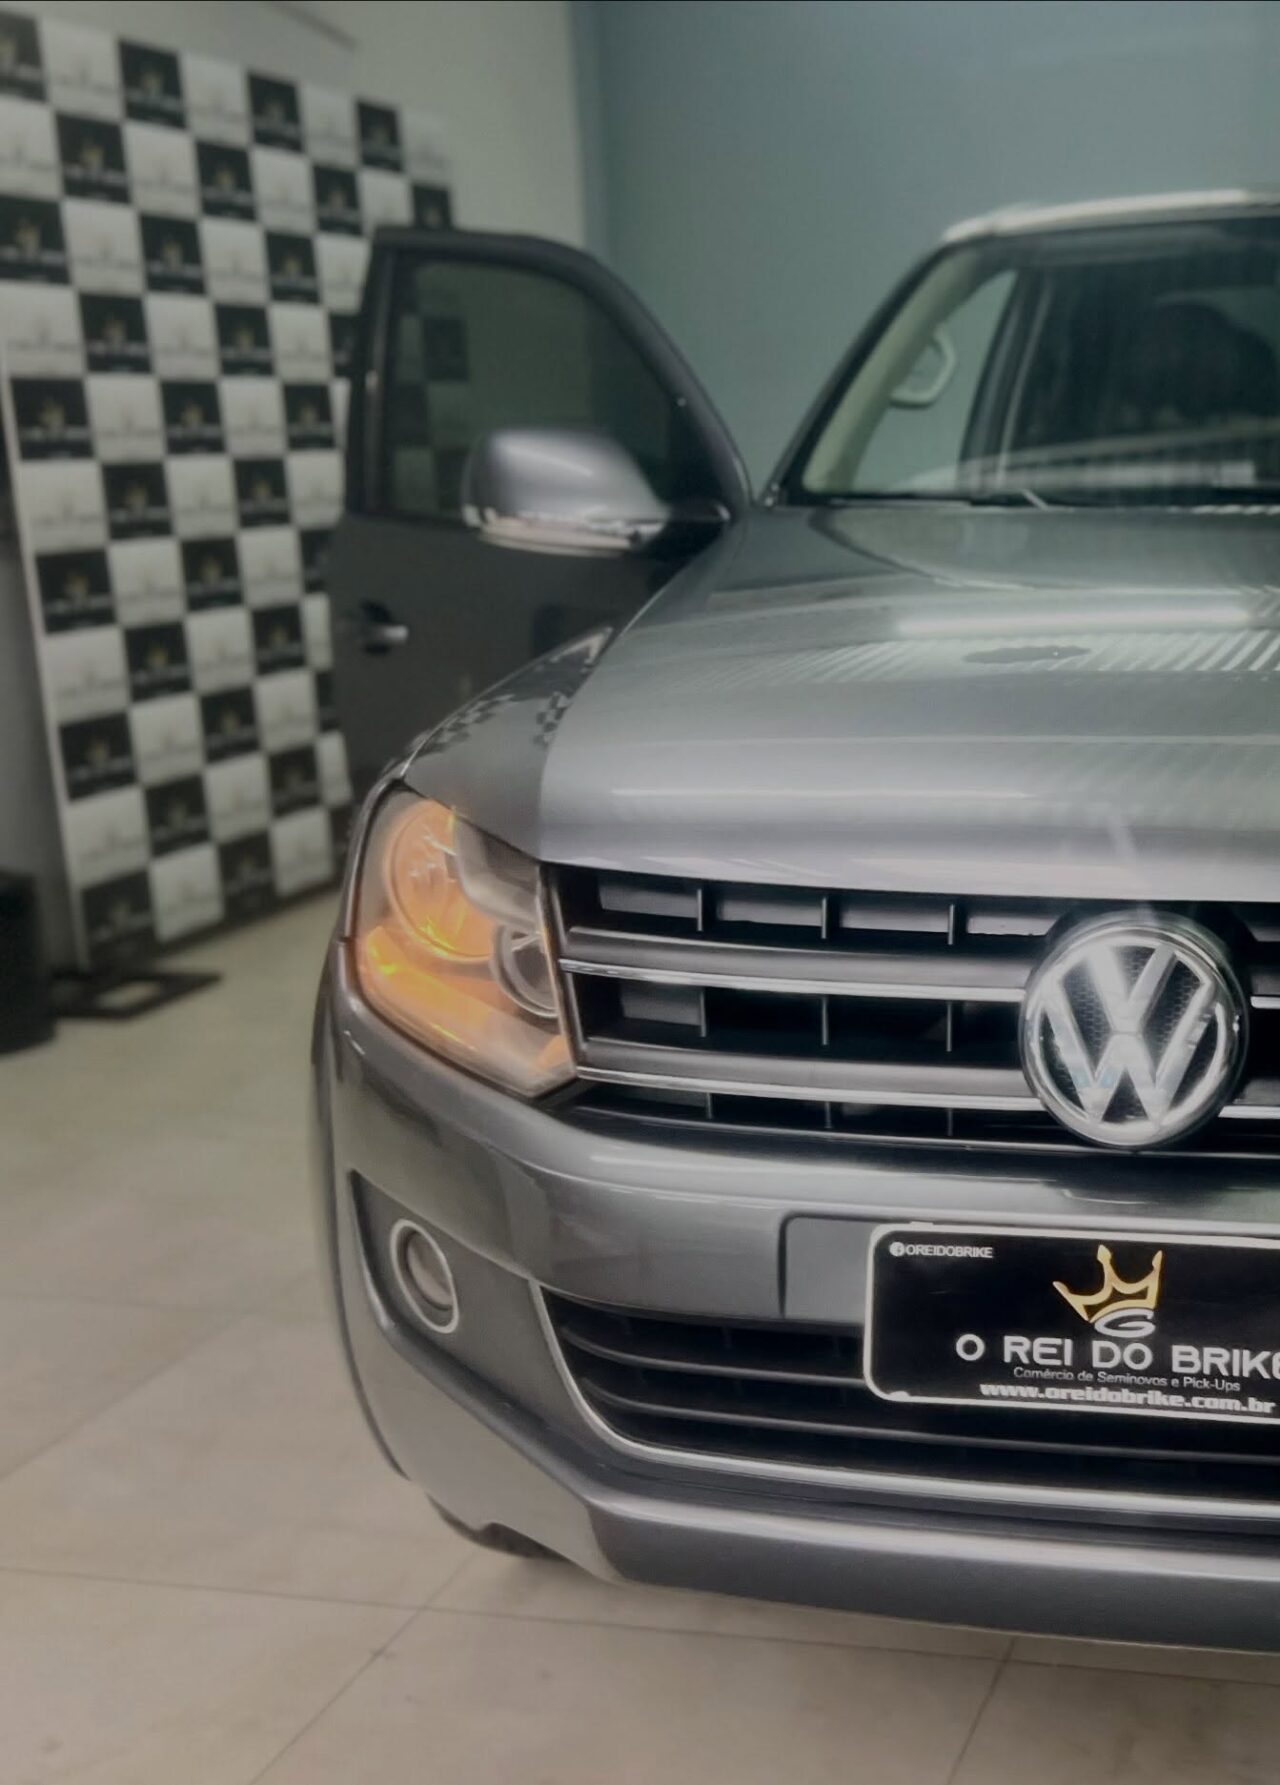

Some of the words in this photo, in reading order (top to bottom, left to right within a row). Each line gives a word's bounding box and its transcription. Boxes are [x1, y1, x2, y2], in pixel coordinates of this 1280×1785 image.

[1028, 924, 1230, 1144] VW
[904, 1244, 993, 1259] OREIDOBRIKE
[955, 1333, 986, 1361] O
[1003, 1335, 1073, 1366] REI
[1092, 1340, 1153, 1370] DO
[1013, 1366, 1074, 1381] Comércio
[1077, 1369, 1094, 1381] de
[1097, 1371, 1168, 1388] Seminovos
[1170, 1377, 1180, 1388] e
[1183, 1376, 1241, 1392] Pick-Ups
[979, 1383, 1276, 1414] www.oreidobrike.com.br
